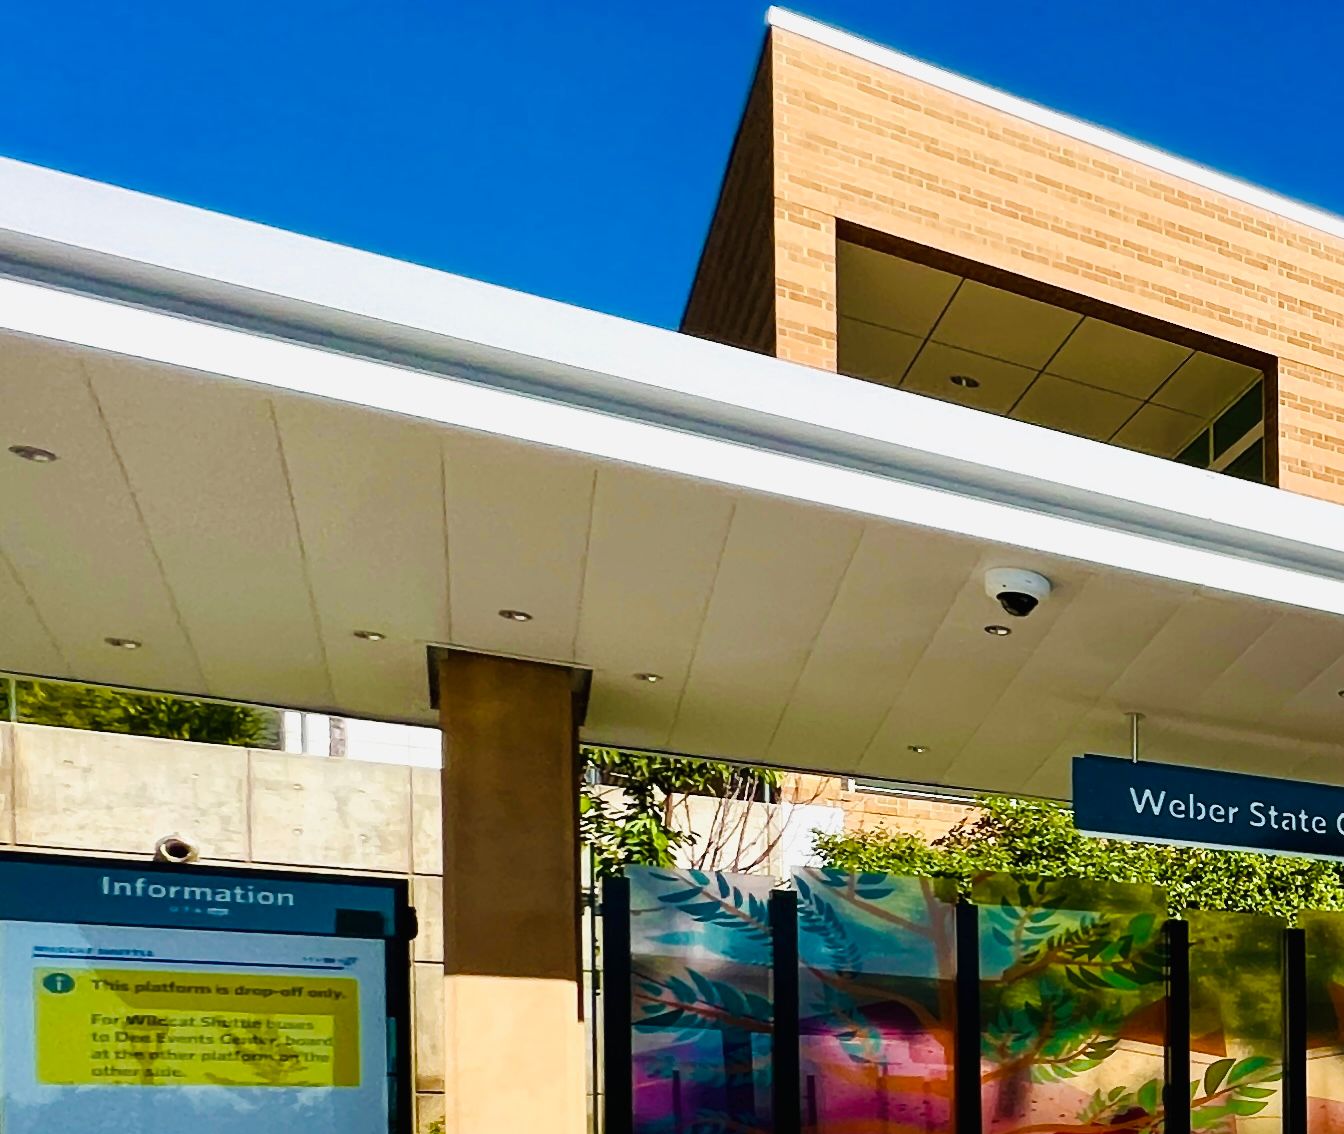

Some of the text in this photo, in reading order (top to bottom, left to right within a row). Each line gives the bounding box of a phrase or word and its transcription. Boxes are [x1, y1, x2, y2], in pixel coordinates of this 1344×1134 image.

[1130, 786, 1239, 824] Weber
[1250, 802, 1327, 834] State
[103, 876, 295, 906] Information
[91, 979, 347, 1001] This platform is drop-off only.
[91, 1014, 119, 1026] For
[92, 1032, 110, 1043] to
